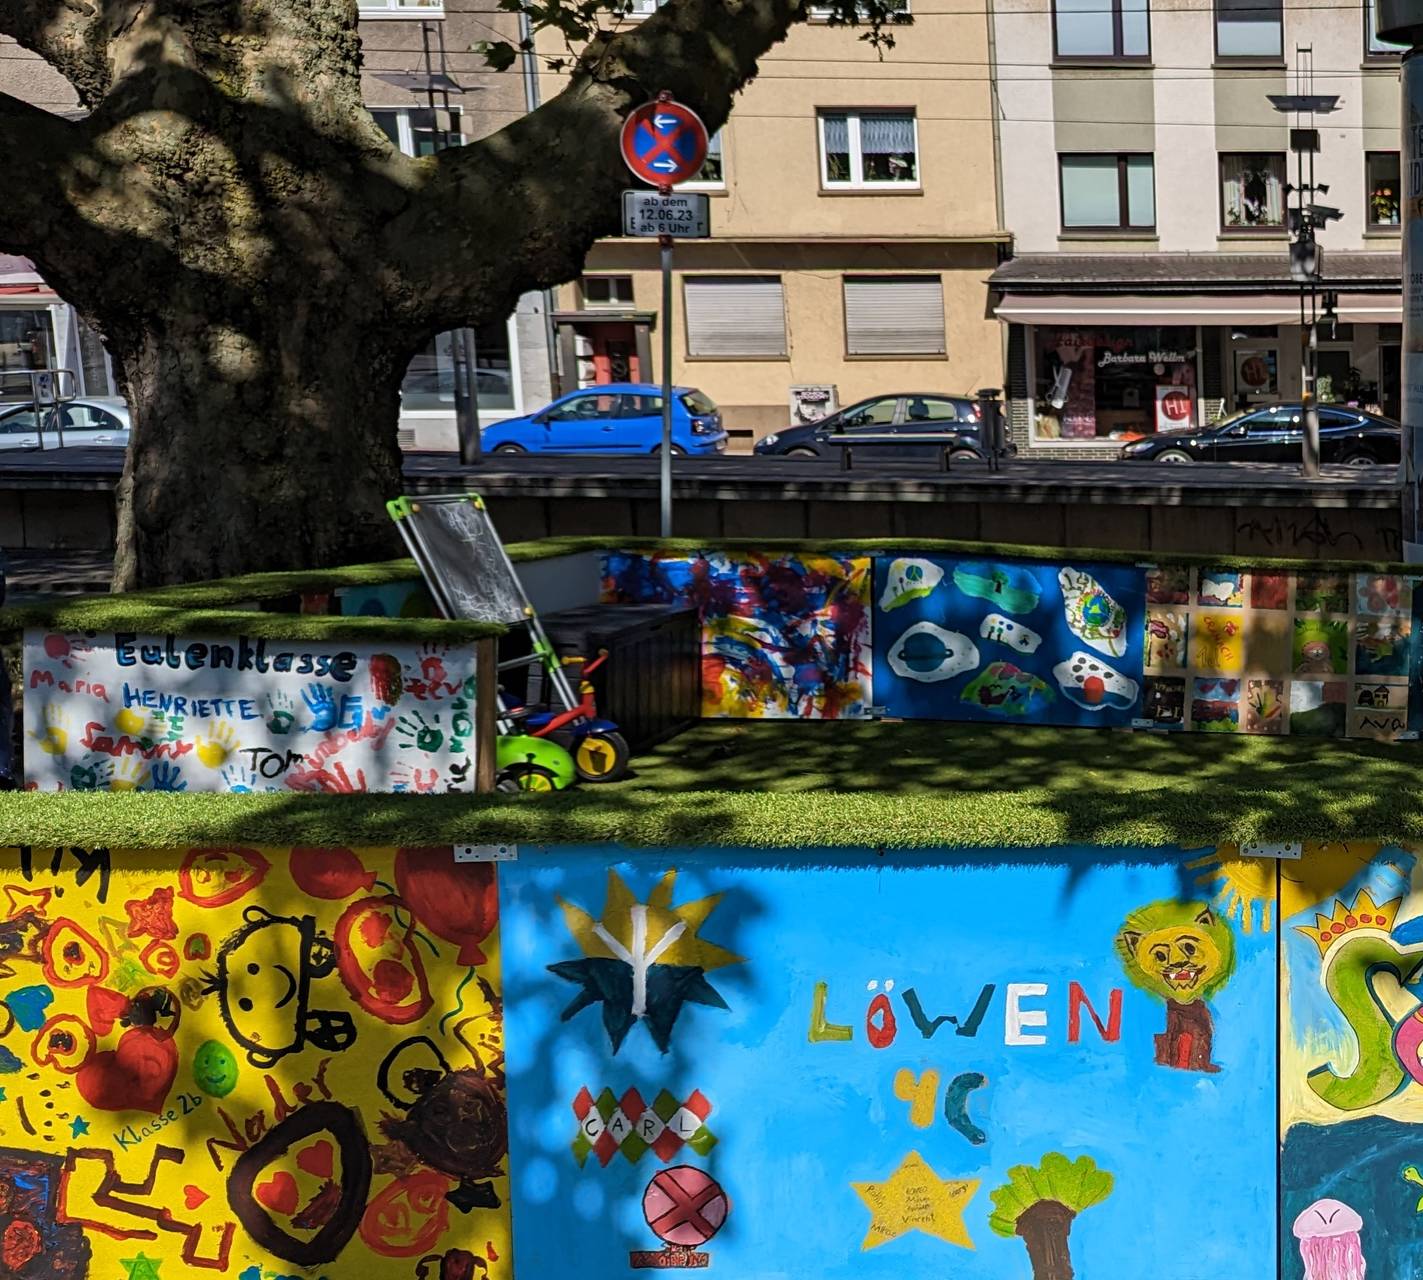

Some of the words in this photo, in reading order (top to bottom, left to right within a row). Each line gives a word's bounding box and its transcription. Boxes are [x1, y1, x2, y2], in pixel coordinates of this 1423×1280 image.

[643, 197, 658, 207] ab
[662, 197, 688, 207] dem
[639, 209, 693, 221] 12.06.23
[640, 223, 655, 233] ab
[658, 223, 665, 233] 6
[668, 223, 690, 233] Uhr
[1098, 352, 1147, 367] Barbara
[115, 632, 357, 682] Eulenklasse
[30, 669, 110, 703] Maria
[122, 681, 260, 720] HENRIETTE
[807, 978, 1124, 1049] LÖWEN
[113, 1109, 179, 1152] Klasse
[176, 1093, 203, 1116] 2b
[584, 1115, 692, 1137] CARL
[901, 1213, 936, 1224] Vincent
